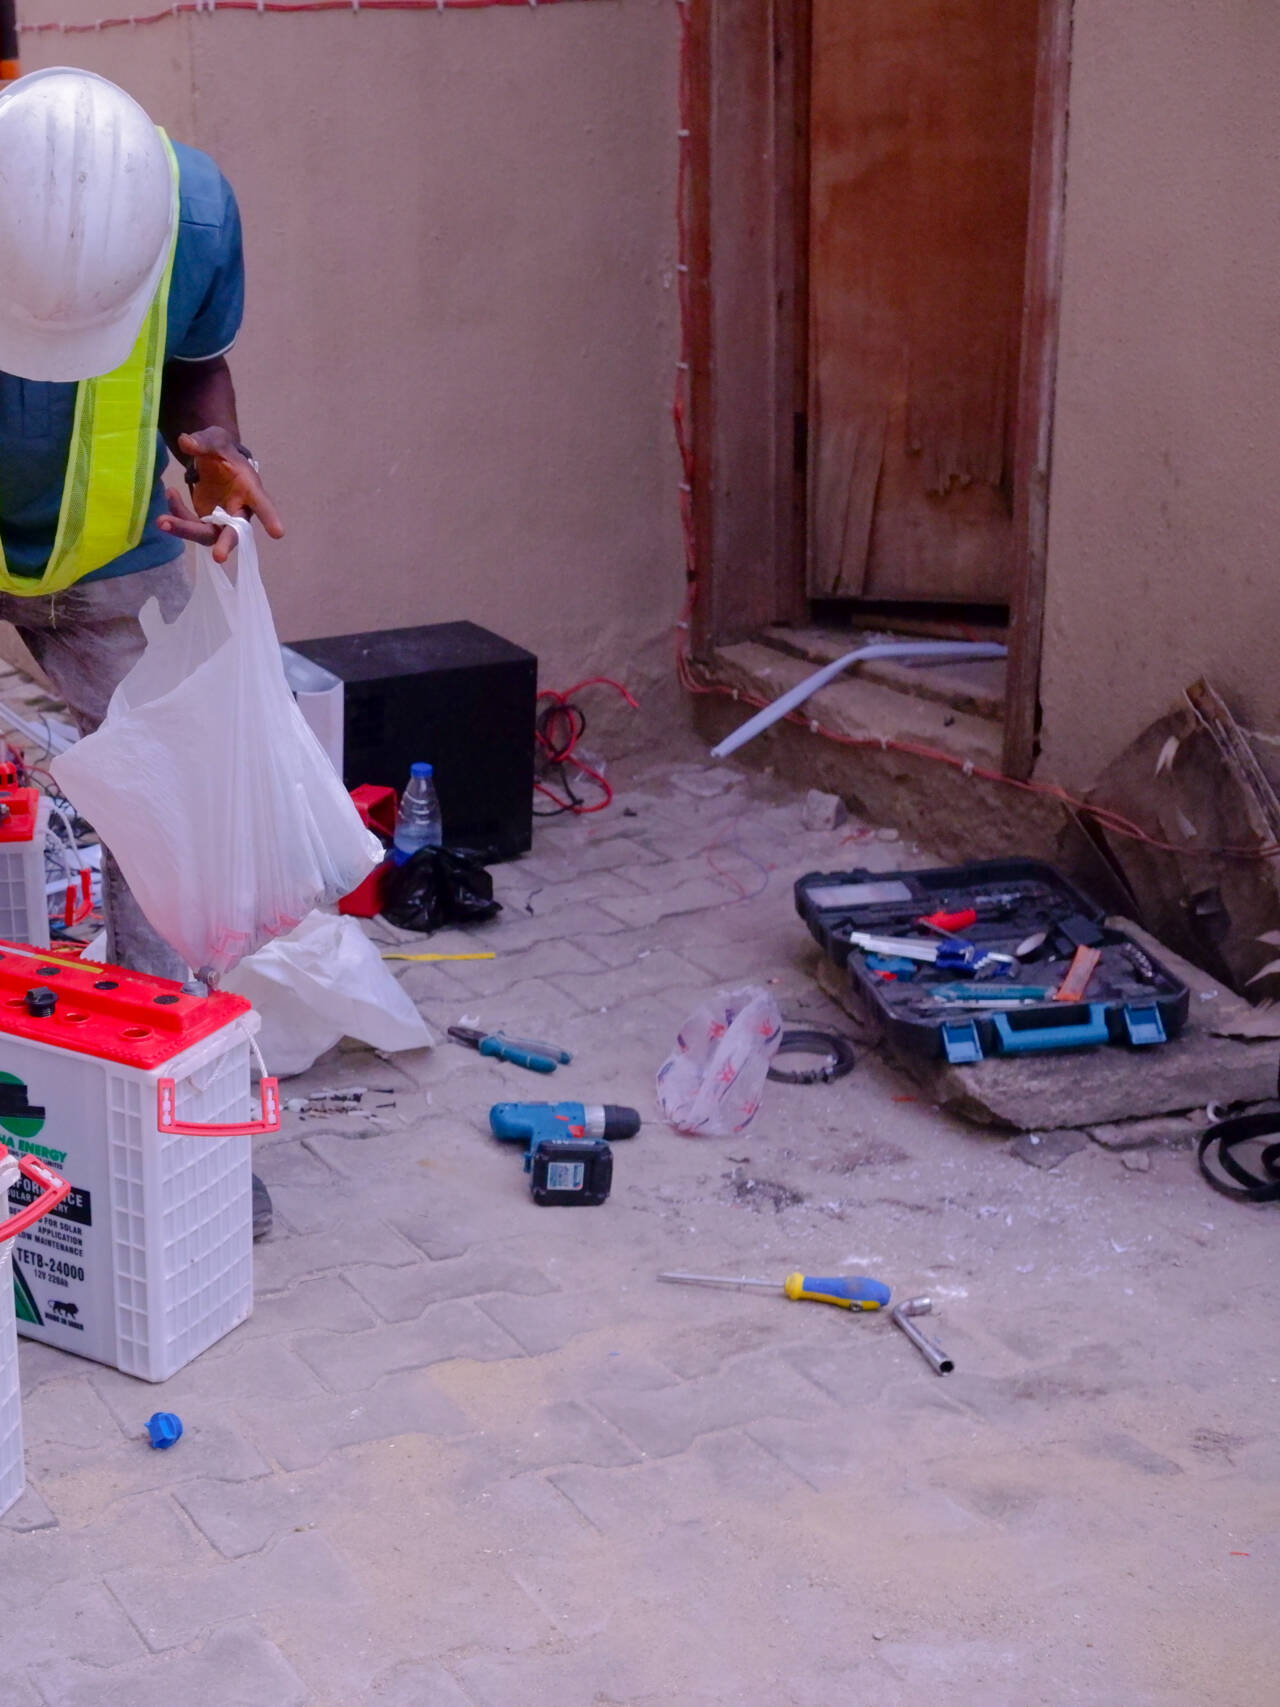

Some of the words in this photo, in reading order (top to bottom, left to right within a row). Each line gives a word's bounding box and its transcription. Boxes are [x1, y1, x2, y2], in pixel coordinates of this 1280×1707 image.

[19, 1139, 67, 1163] ENERGY
[38, 1226, 83, 1246] APPLICATION
[44, 1217, 58, 1228] FOR
[60, 1222, 82, 1236] SOLAR
[34, 1235, 83, 1257] MAINTENANCE
[17, 1248, 85, 1282] TETB-24000
[34, 1269, 46, 1281] 12V
